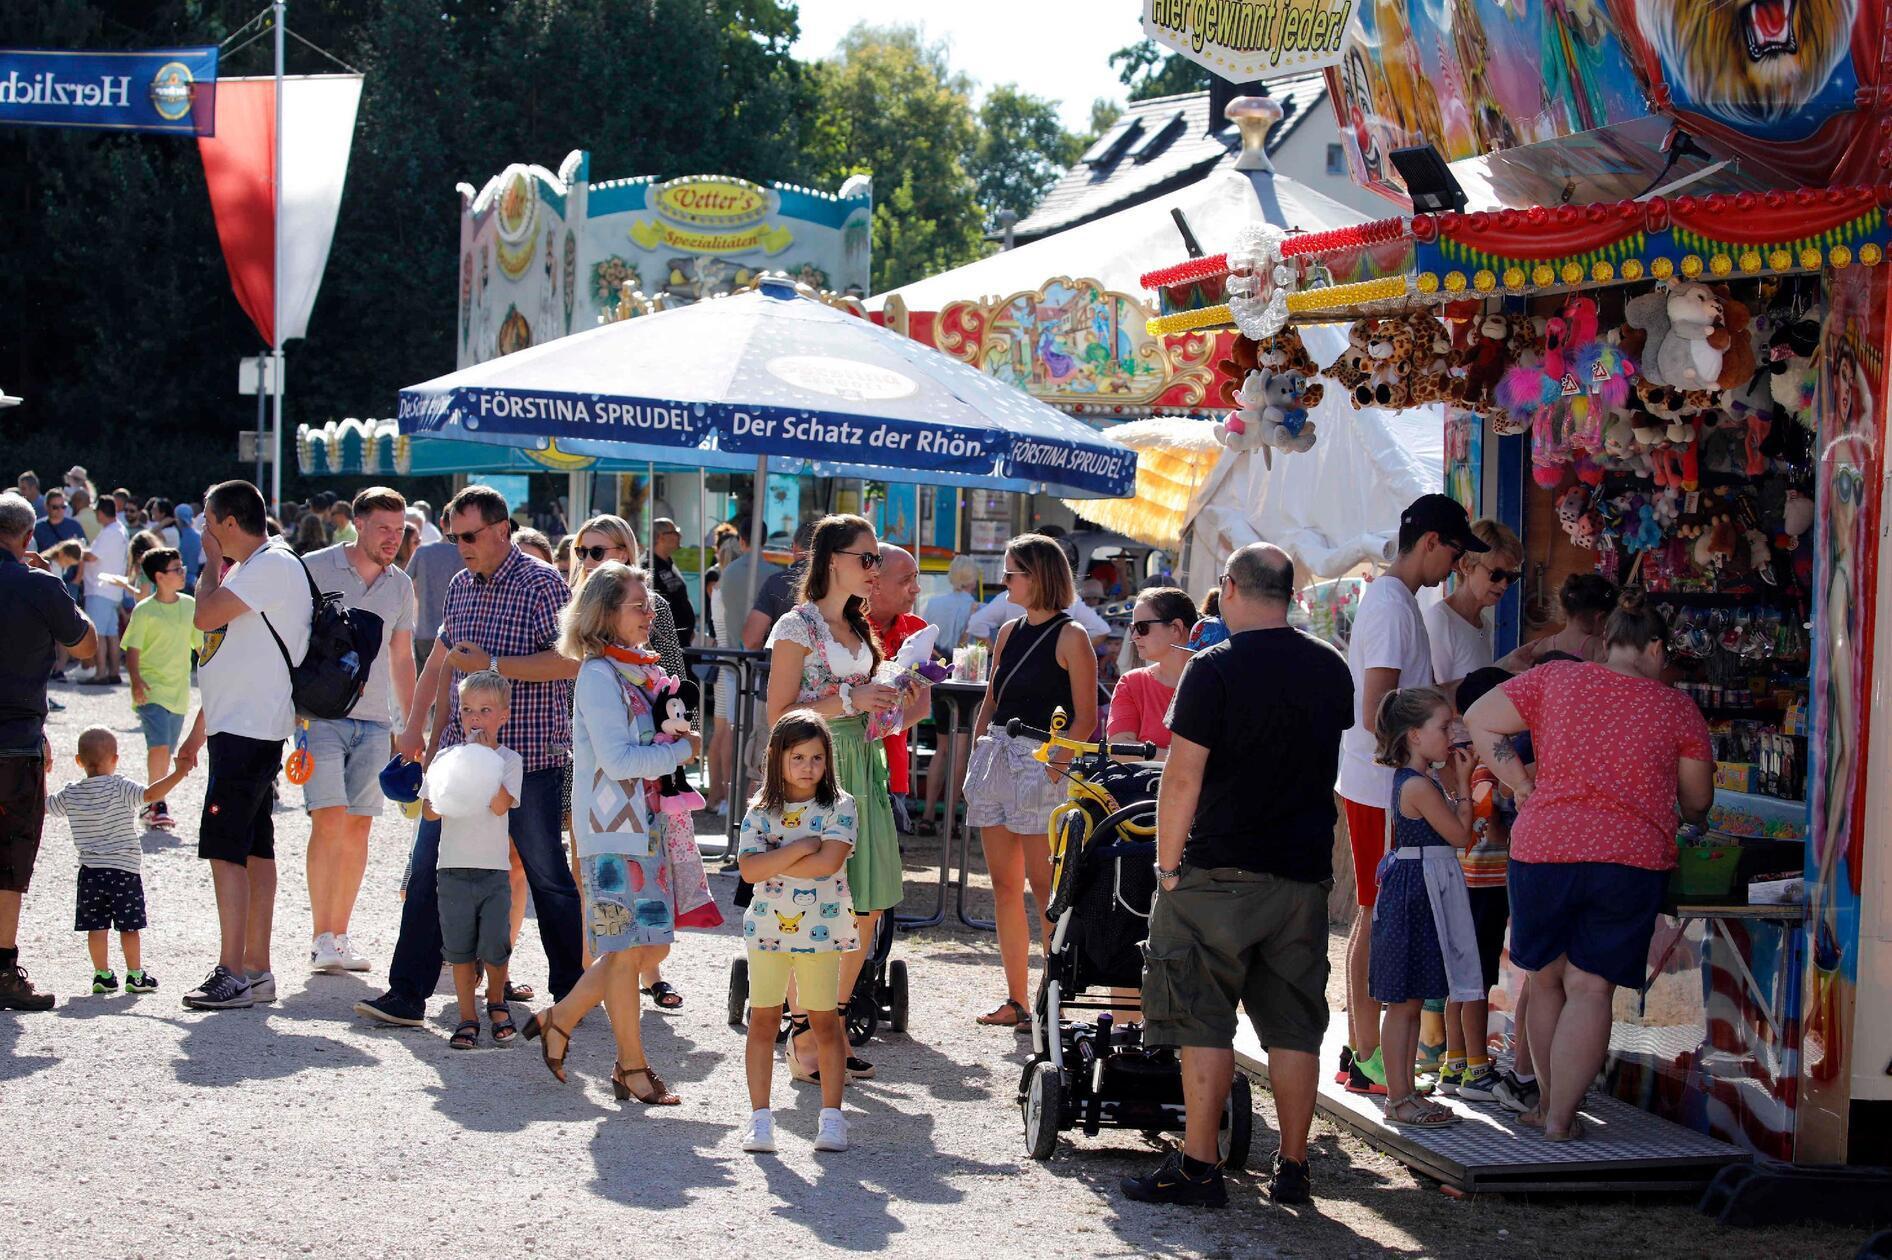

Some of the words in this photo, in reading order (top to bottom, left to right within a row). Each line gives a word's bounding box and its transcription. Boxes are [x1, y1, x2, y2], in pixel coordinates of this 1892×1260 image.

[1191, 0, 1279, 53] gewinnt
[1270, 0, 1352, 66] jeder!
[673, 188, 754, 211] Vetter's
[480, 391, 590, 422] FÖRSTINA
[594, 402, 694, 432] SPRUDEL
[732, 412, 777, 437] Der
[782, 416, 864, 445] Schatz
[868, 424, 912, 449] der
[916, 430, 987, 457] Rhön.
[1011, 437, 1069, 468] FÖRSTINA
[1066, 449, 1123, 479] SPRUDEL
